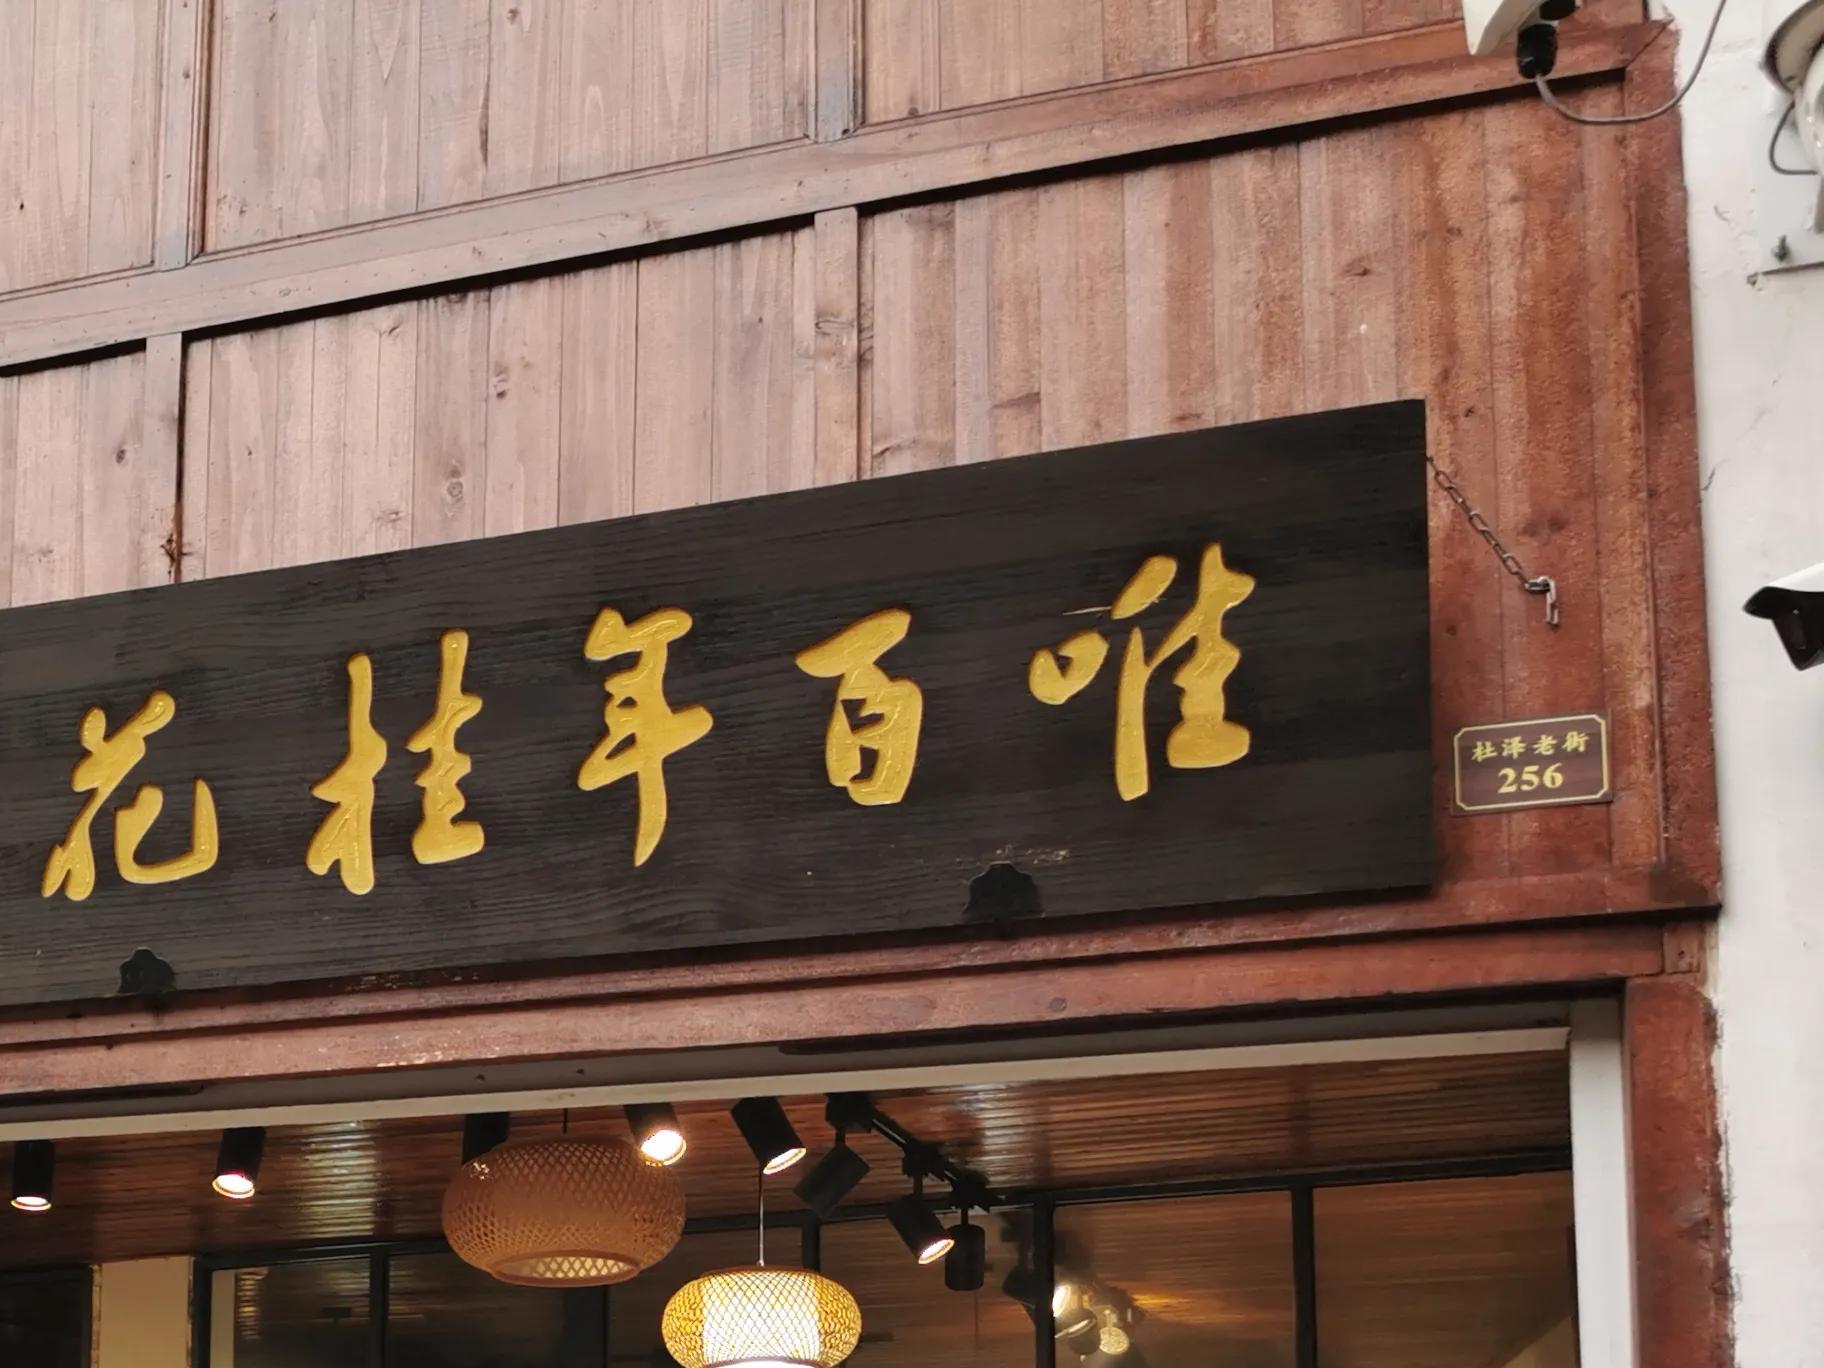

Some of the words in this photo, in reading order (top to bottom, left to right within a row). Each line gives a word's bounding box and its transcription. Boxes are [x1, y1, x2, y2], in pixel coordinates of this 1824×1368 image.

[1472, 731, 1589, 762] 杜泽老街
[1497, 763, 1564, 794] 256
